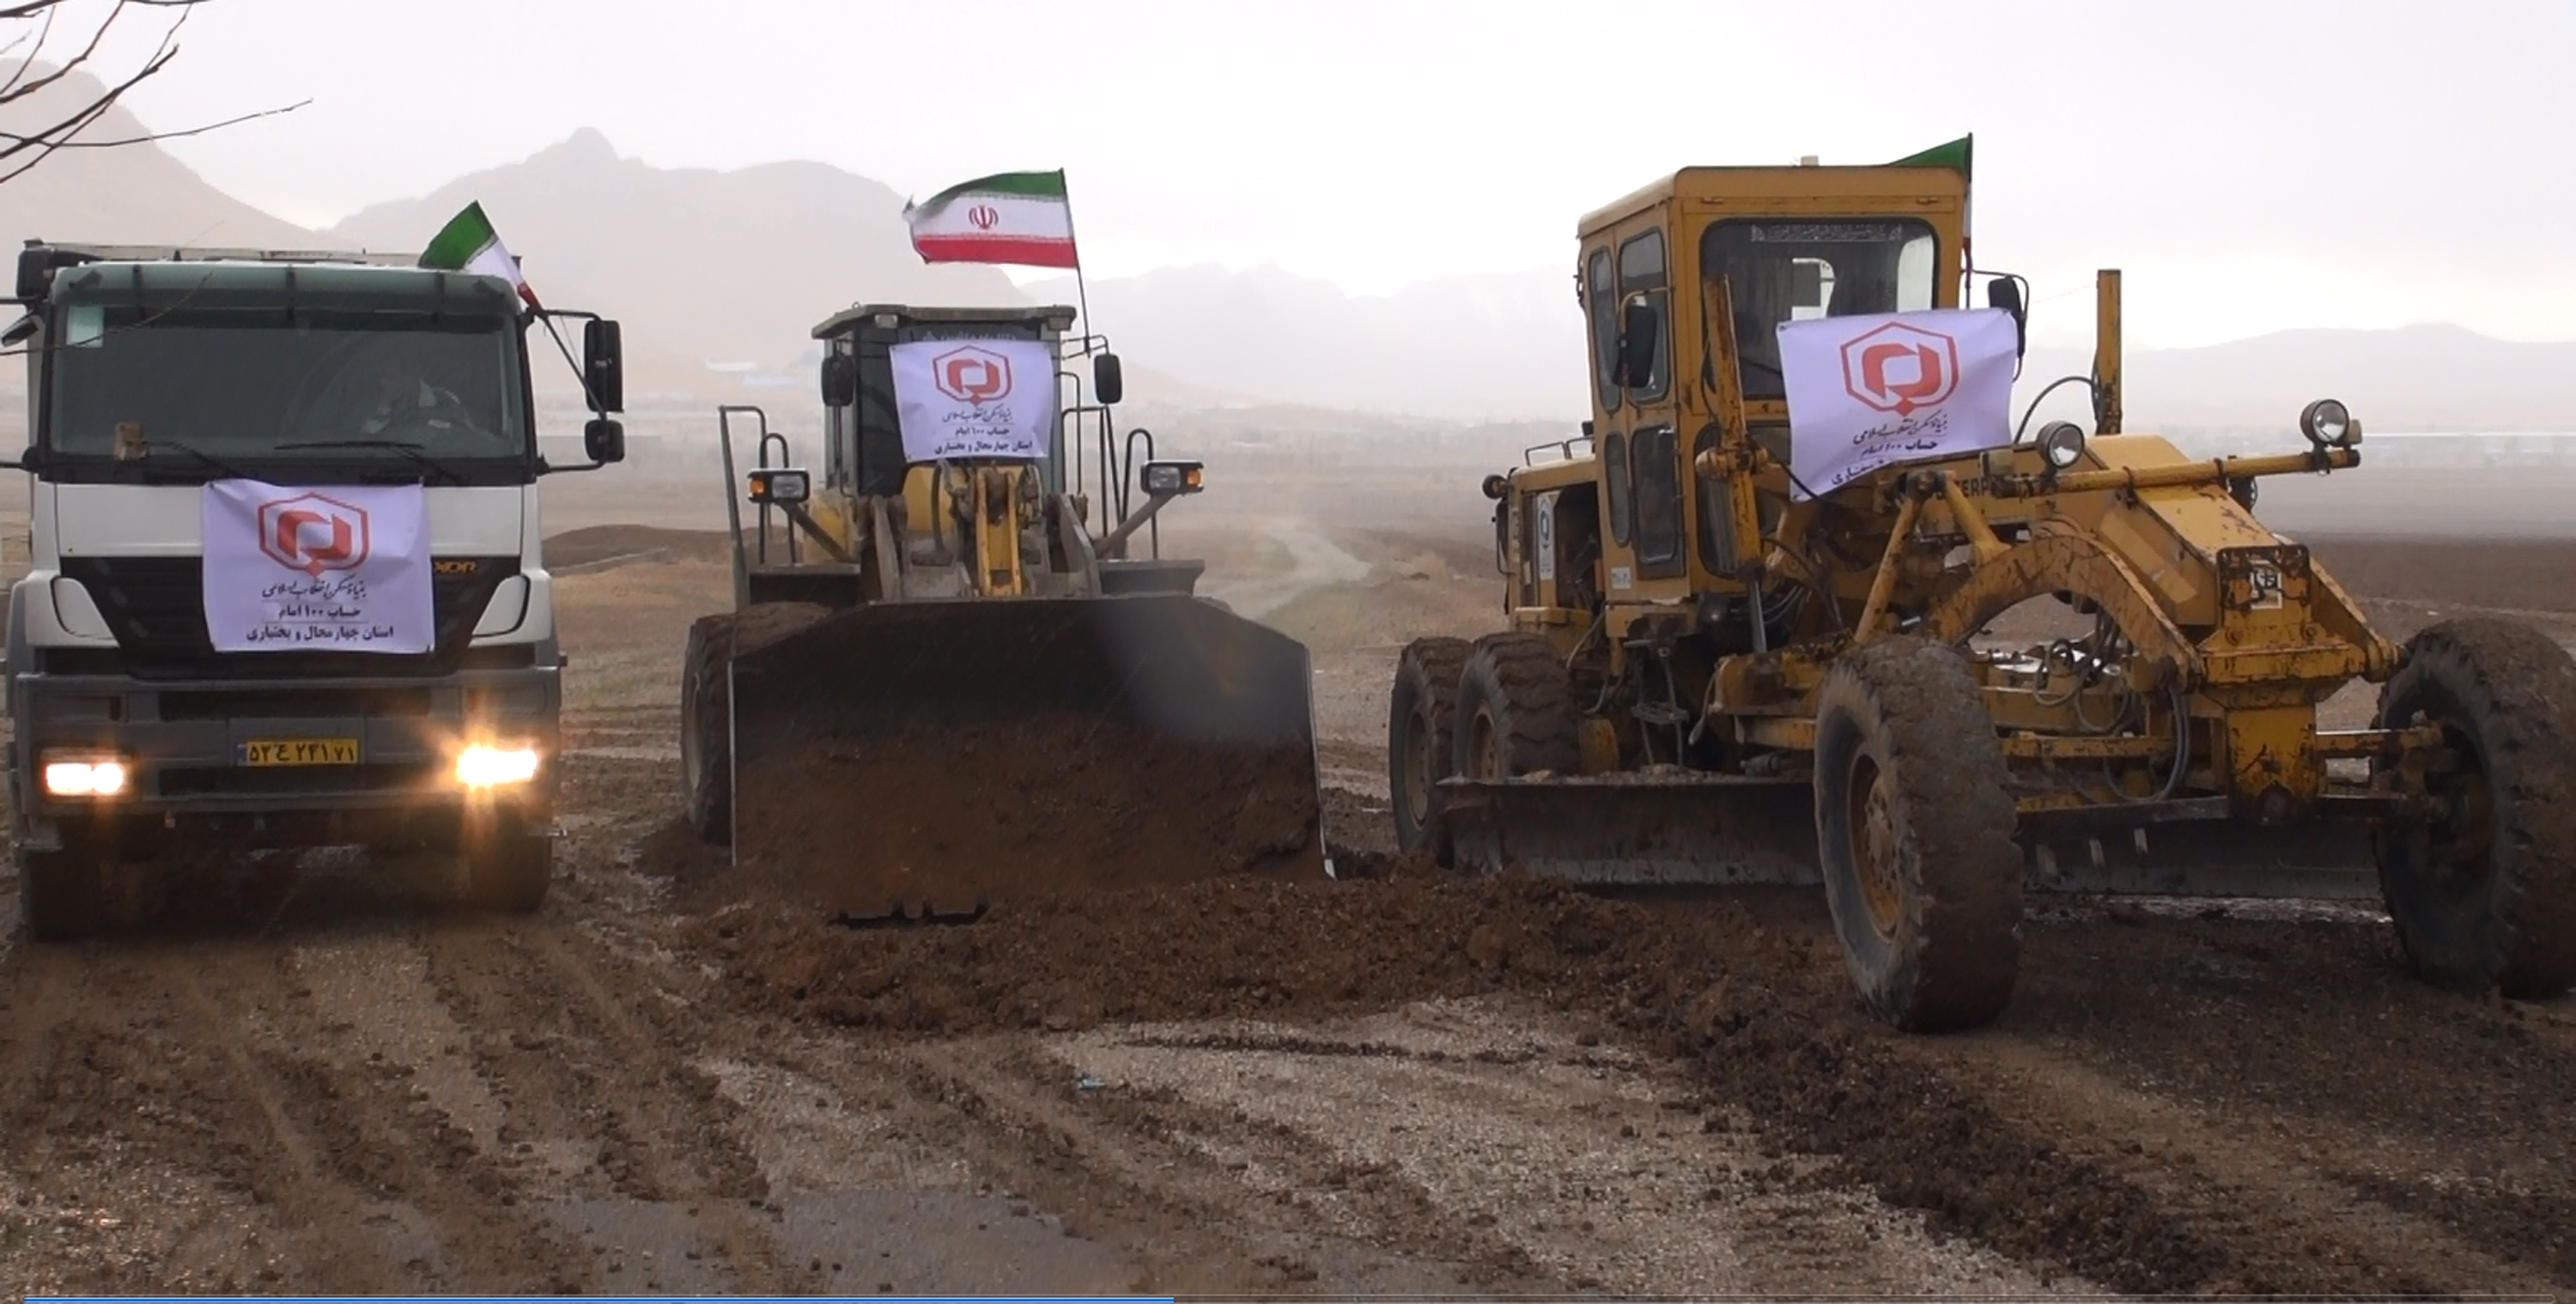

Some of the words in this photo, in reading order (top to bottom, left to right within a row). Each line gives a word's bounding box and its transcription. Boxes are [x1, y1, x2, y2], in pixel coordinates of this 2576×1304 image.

[1905, 439, 1938, 452] حساب
[279, 604, 301, 619] امام
[305, 604, 323, 617] ۱۰۰
[327, 604, 361, 617] حساب
[246, 626, 291, 641] بختیاری
[295, 631, 301, 640] و
[361, 626, 393, 640] استان
